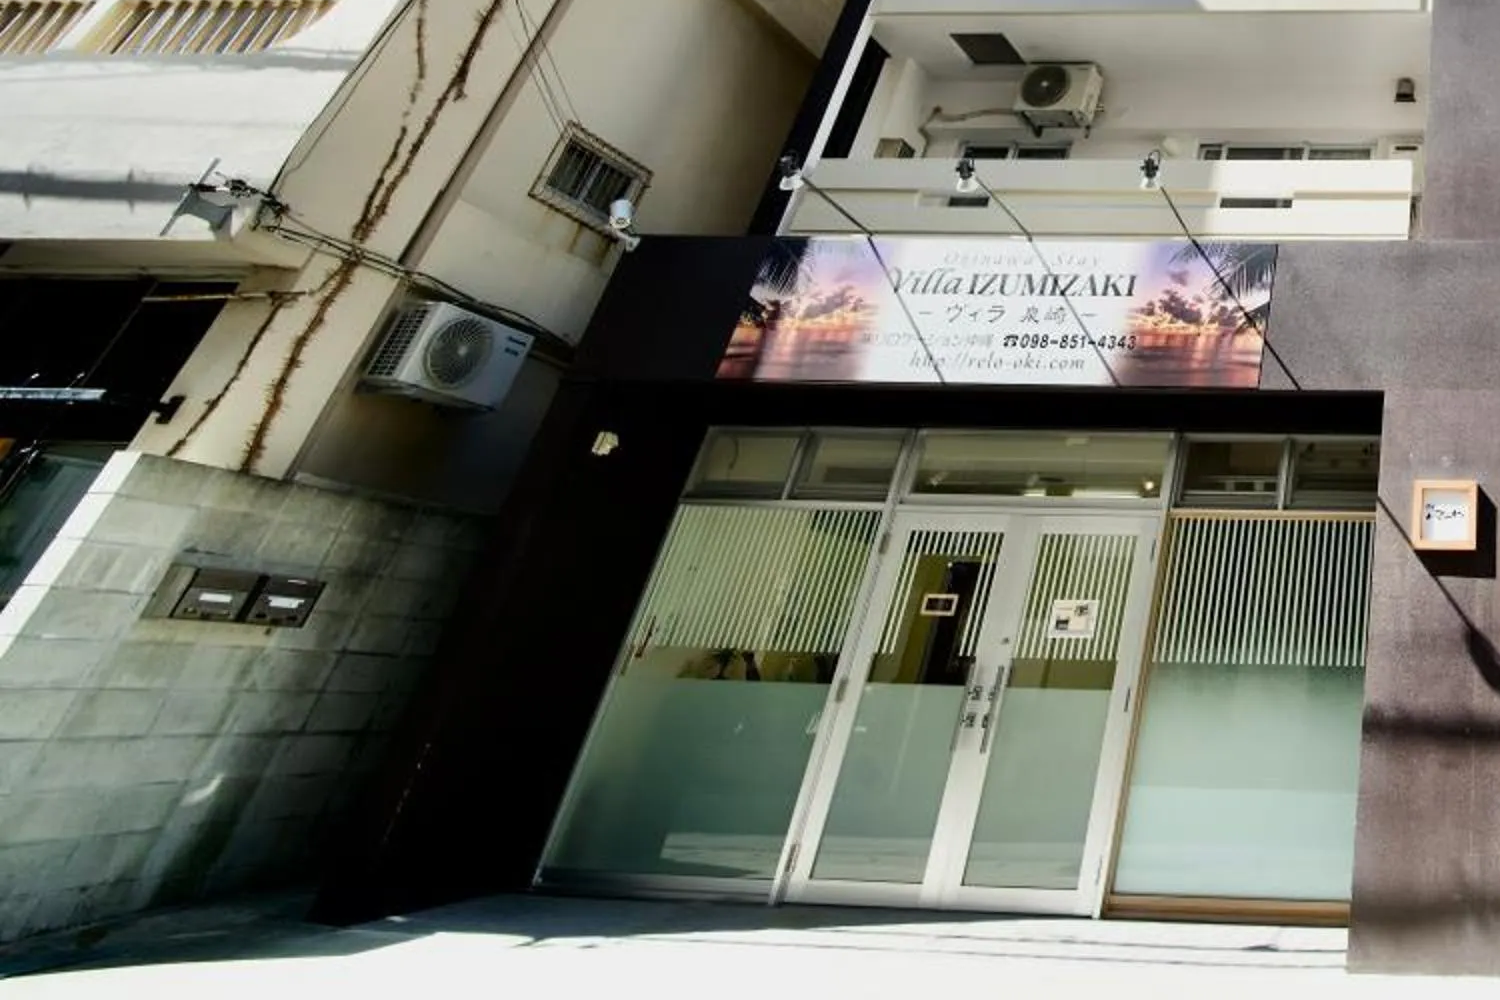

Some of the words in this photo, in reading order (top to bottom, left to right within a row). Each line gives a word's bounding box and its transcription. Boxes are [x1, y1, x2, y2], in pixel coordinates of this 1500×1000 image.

[889, 266, 963, 295] Villa
[966, 272, 1138, 297] IZUMIZAKI
[1019, 332, 1137, 350] 098-851-4343
